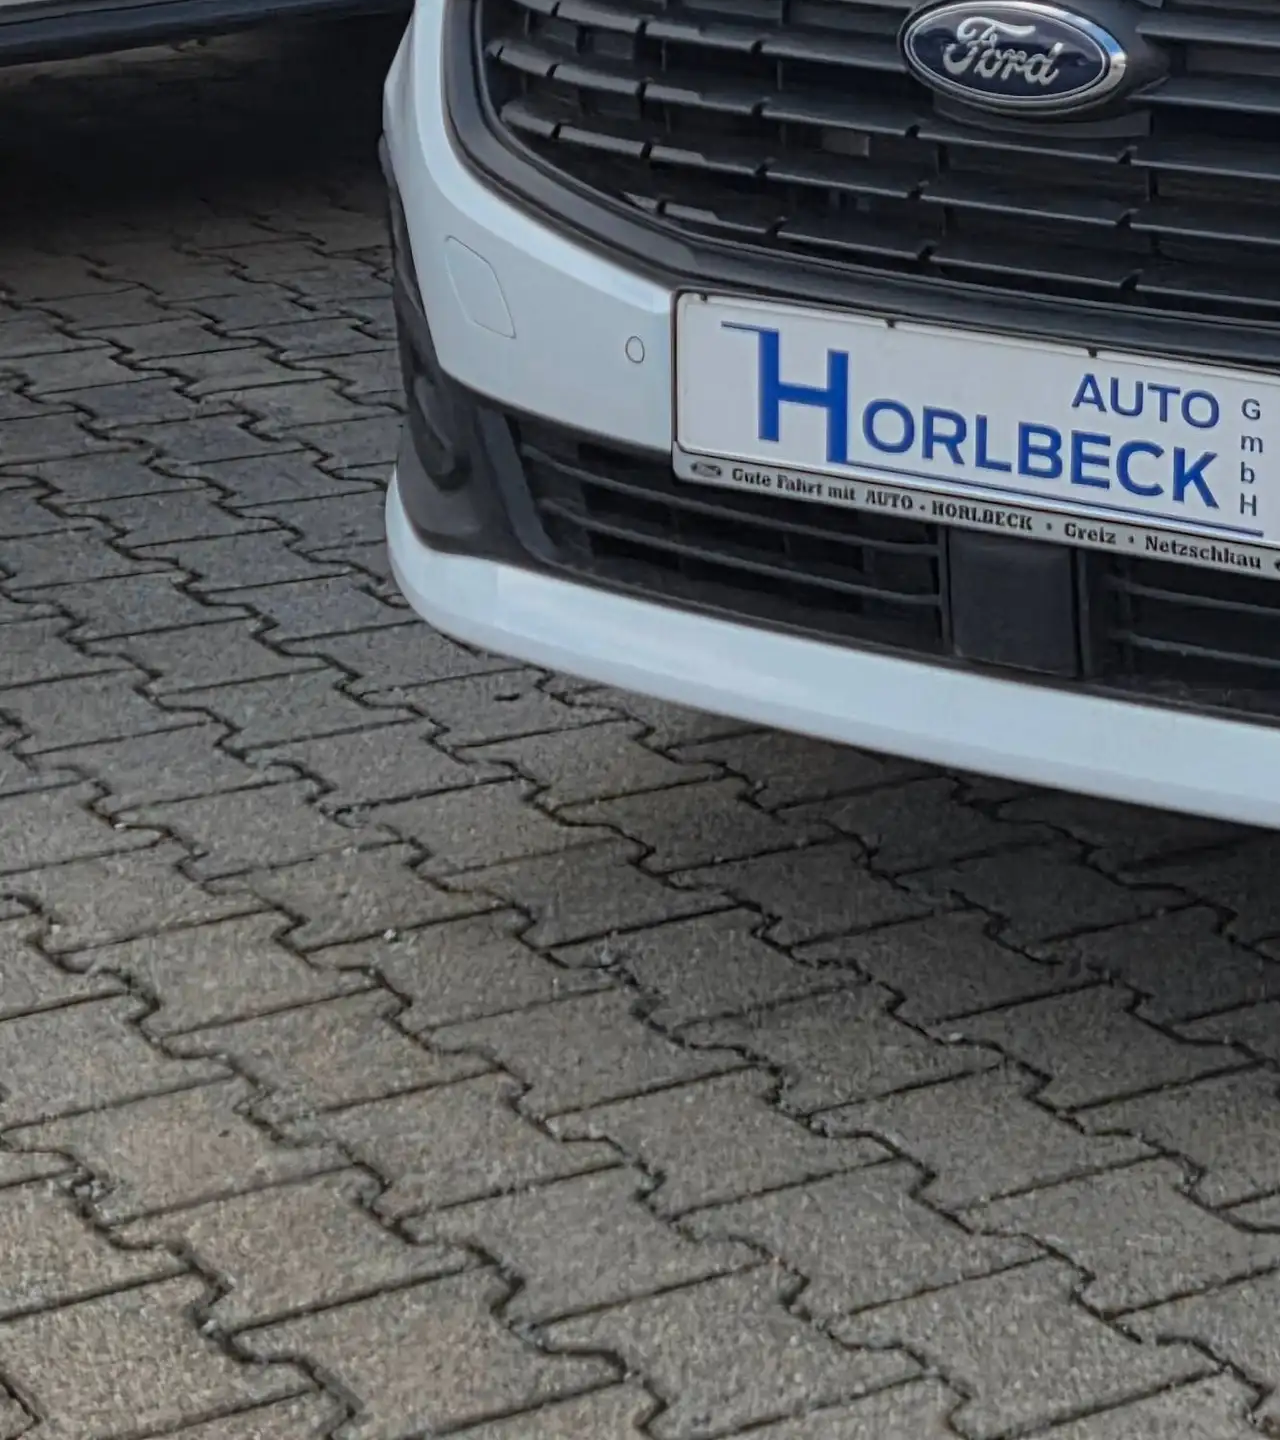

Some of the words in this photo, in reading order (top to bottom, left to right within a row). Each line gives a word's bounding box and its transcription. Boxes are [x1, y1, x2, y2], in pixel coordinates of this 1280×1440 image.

[942, 16, 1060, 86] Ford
[721, 320, 1220, 510] HORLBECK
[1071, 373, 1220, 429] AUTO
[731, 467, 772, 489] Gute
[776, 474, 823, 496] Fahrt
[828, 484, 856, 501] mit
[865, 489, 914, 510] AUTO
[931, 500, 1034, 531] HORLBECK
[1064, 522, 1117, 545] Greiz
[1145, 535, 1262, 570] Netzschkau
